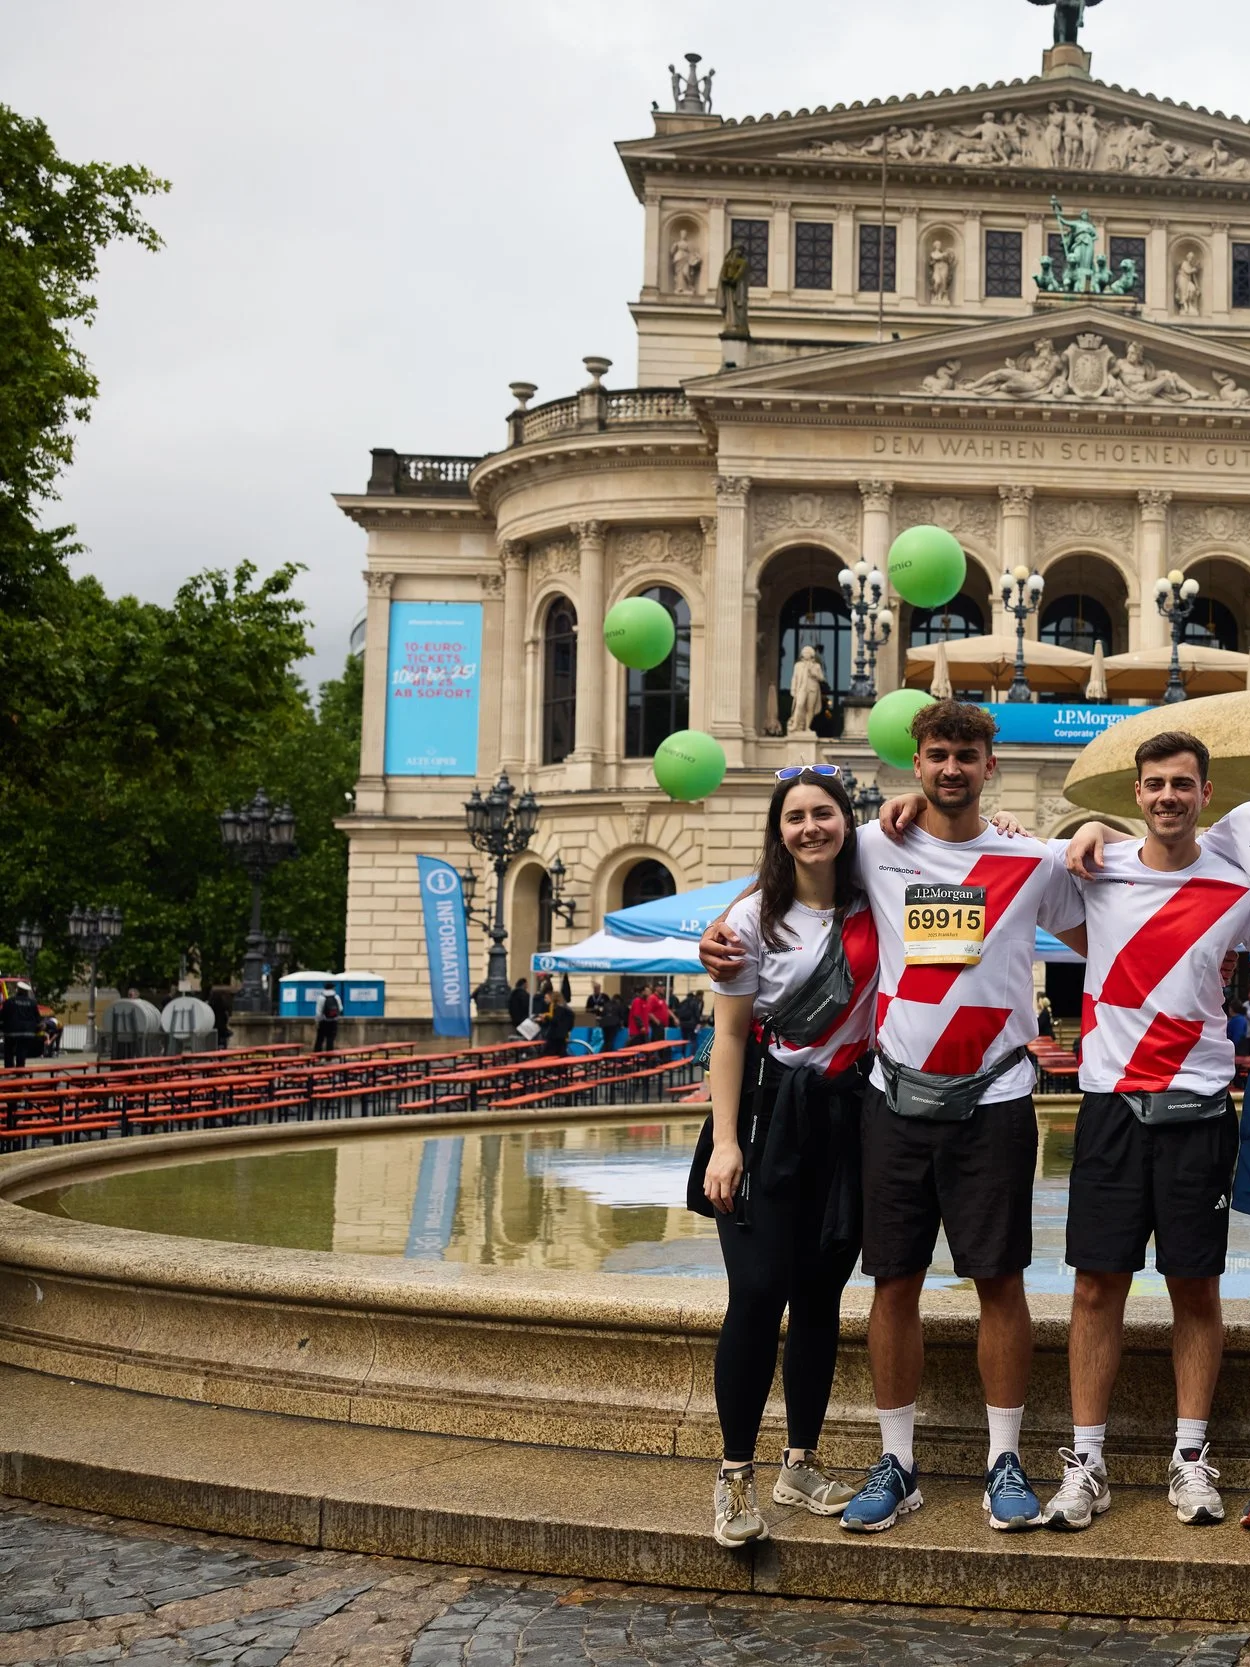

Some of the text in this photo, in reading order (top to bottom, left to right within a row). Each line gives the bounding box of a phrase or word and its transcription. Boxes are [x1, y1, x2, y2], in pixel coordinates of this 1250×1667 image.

[873, 435, 925, 455] DEM
[938, 437, 1046, 460] WAHREN
[1061, 443, 1192, 465] SCHOENEN
[394, 688, 413, 698] AB
[1053, 709, 1134, 728] J.P.Morga
[1054, 728, 1094, 738] Corporate
[879, 864, 914, 875] dormakaba
[914, 888, 973, 902] J.P.Morgan
[908, 908, 981, 930] 69915
[436, 901, 461, 1005] INFORMATION
[807, 998, 830, 1022] dormakaba
[911, 1095, 939, 1105] dormakaba
